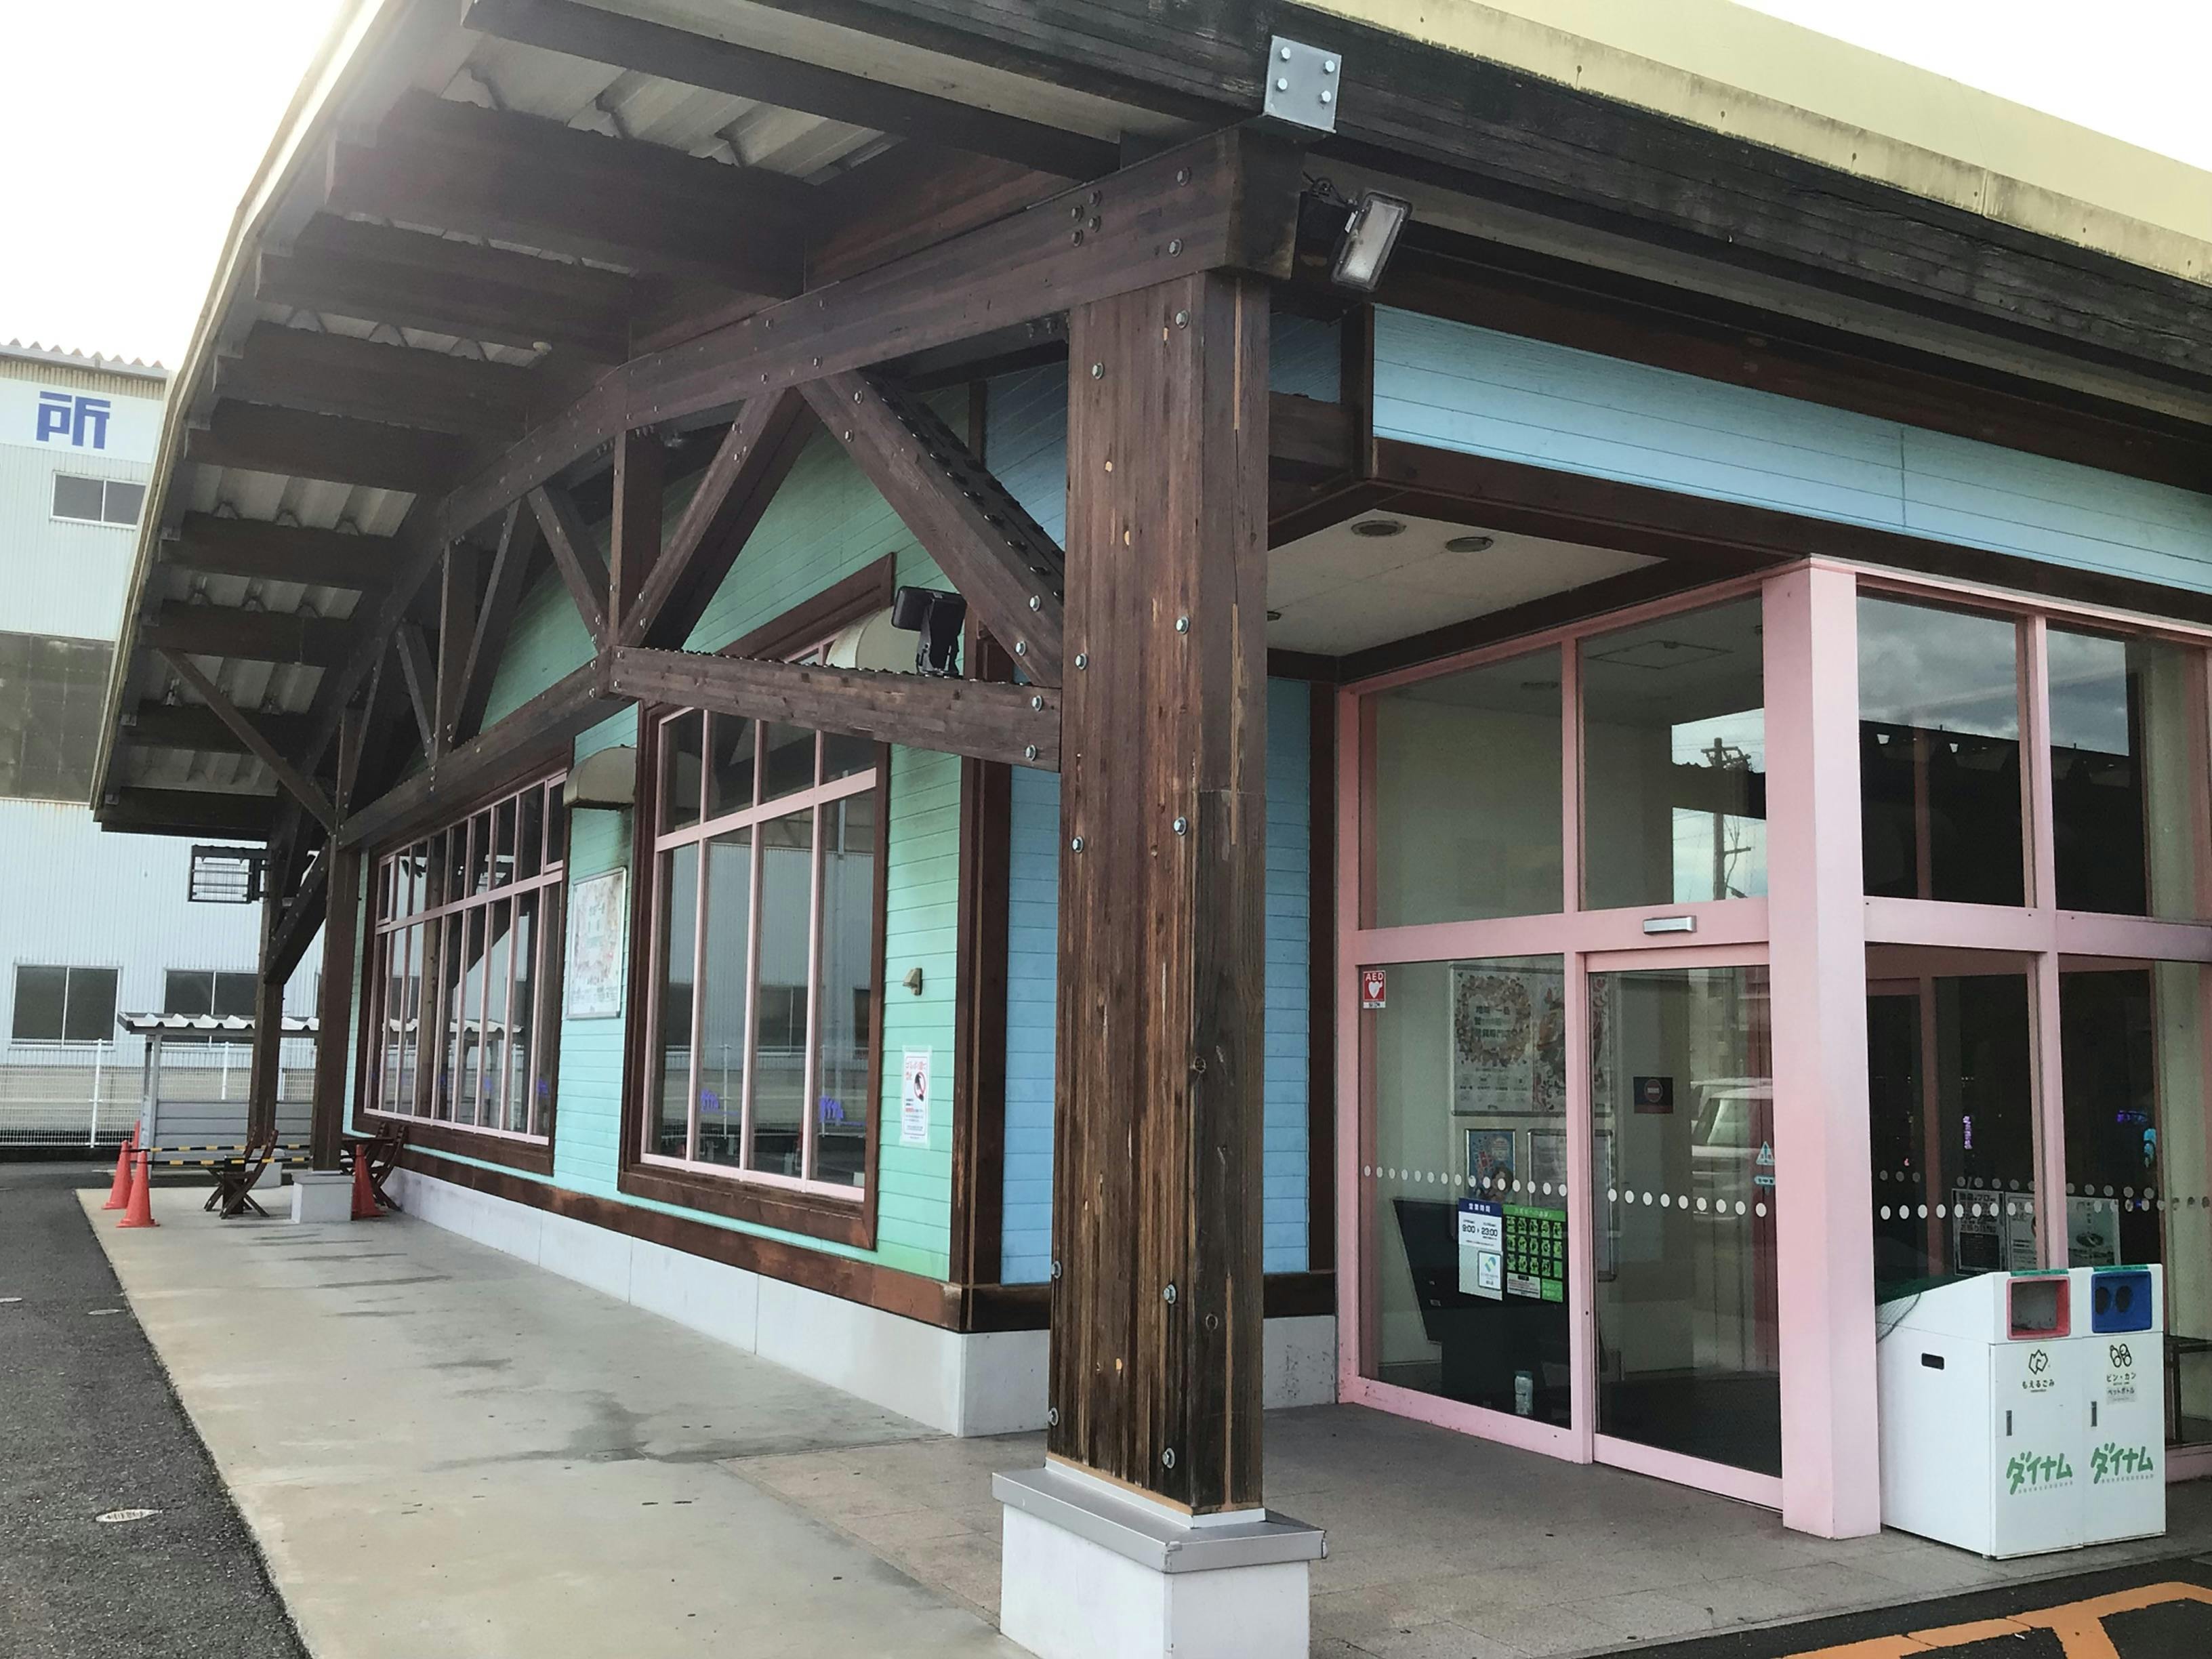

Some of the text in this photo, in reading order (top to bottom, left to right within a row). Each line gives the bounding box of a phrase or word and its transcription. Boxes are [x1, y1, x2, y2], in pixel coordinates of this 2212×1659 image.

[36, 390, 111, 450] 所
[1365, 972, 1384, 982] AED
[1481, 1227, 1498, 1237] 23:00
[2006, 1451, 2073, 1495] ダイナム
[2090, 1441, 2154, 1484] ダイナム
